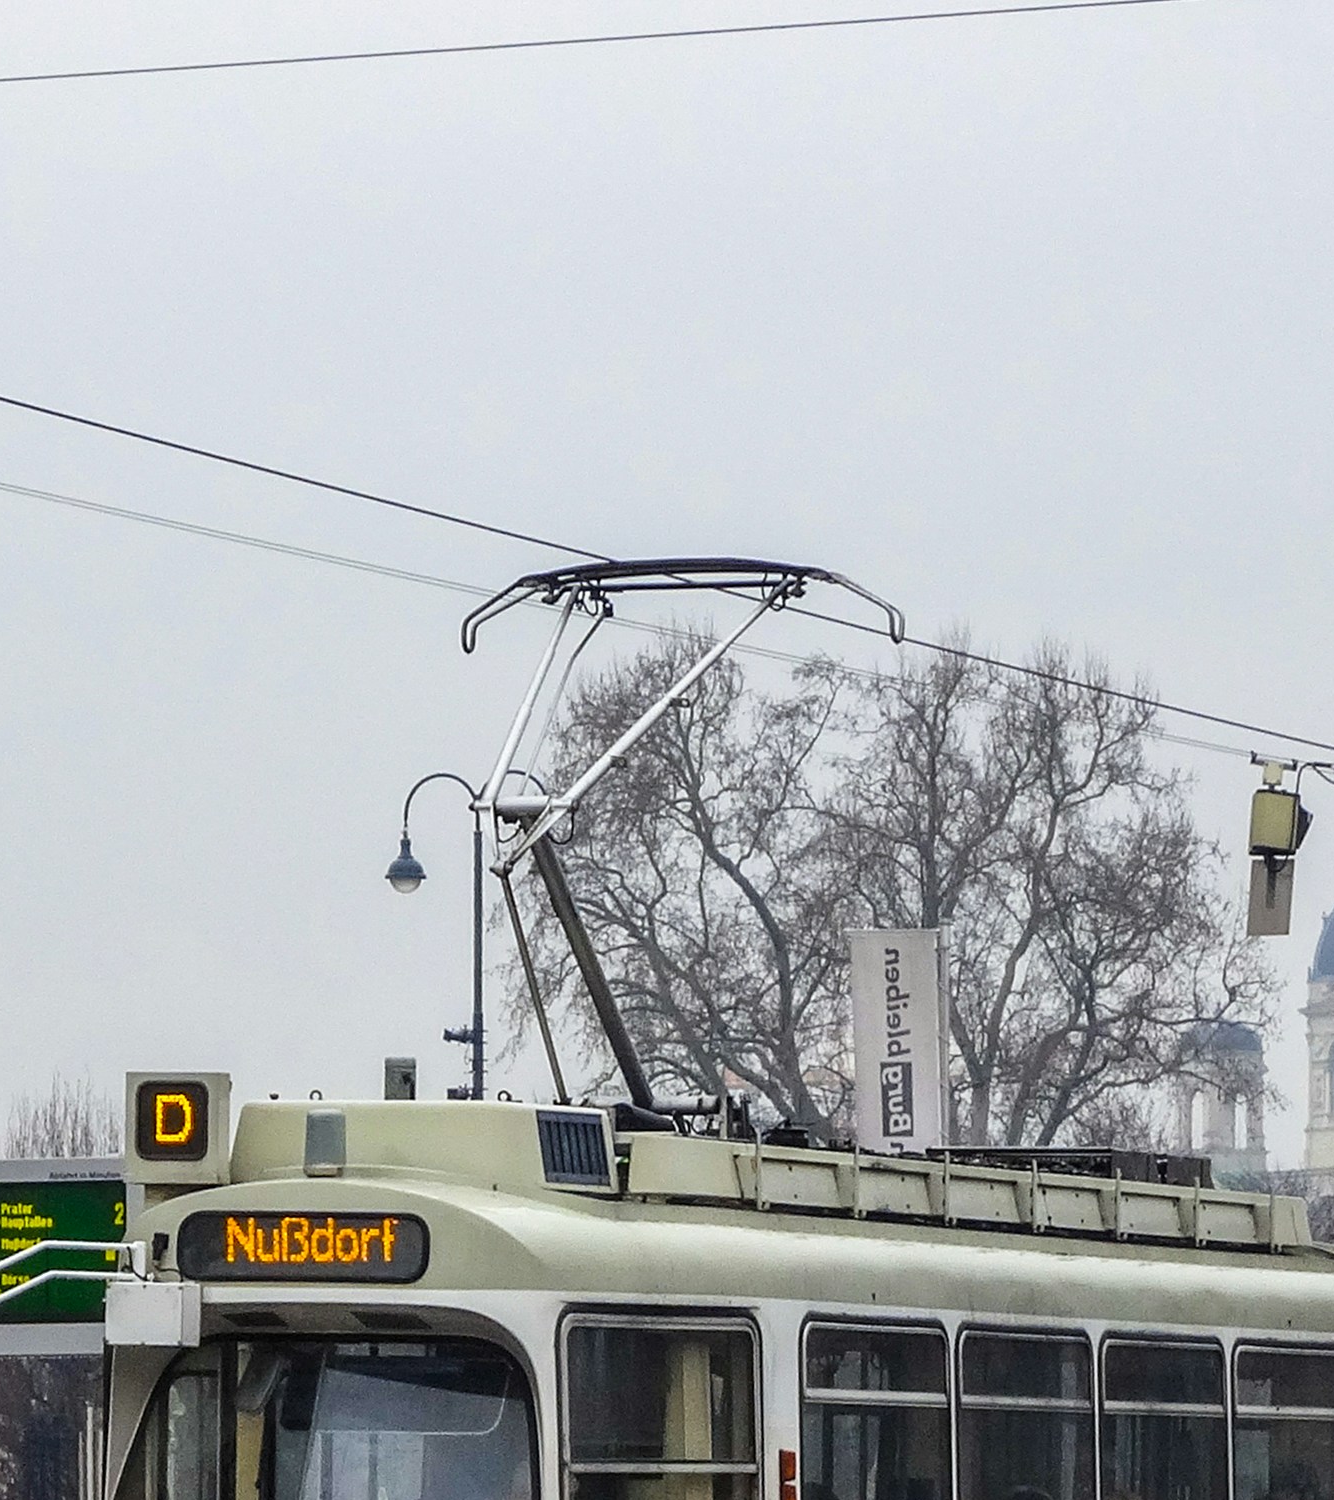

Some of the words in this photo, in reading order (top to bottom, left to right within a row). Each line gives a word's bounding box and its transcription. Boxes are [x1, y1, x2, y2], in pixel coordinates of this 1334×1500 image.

[154, 1093, 193, 1143] D
[0, 1202, 34, 1215] Prater
[114, 1202, 125, 1225] 2
[225, 1216, 400, 1263] Nußdorf
